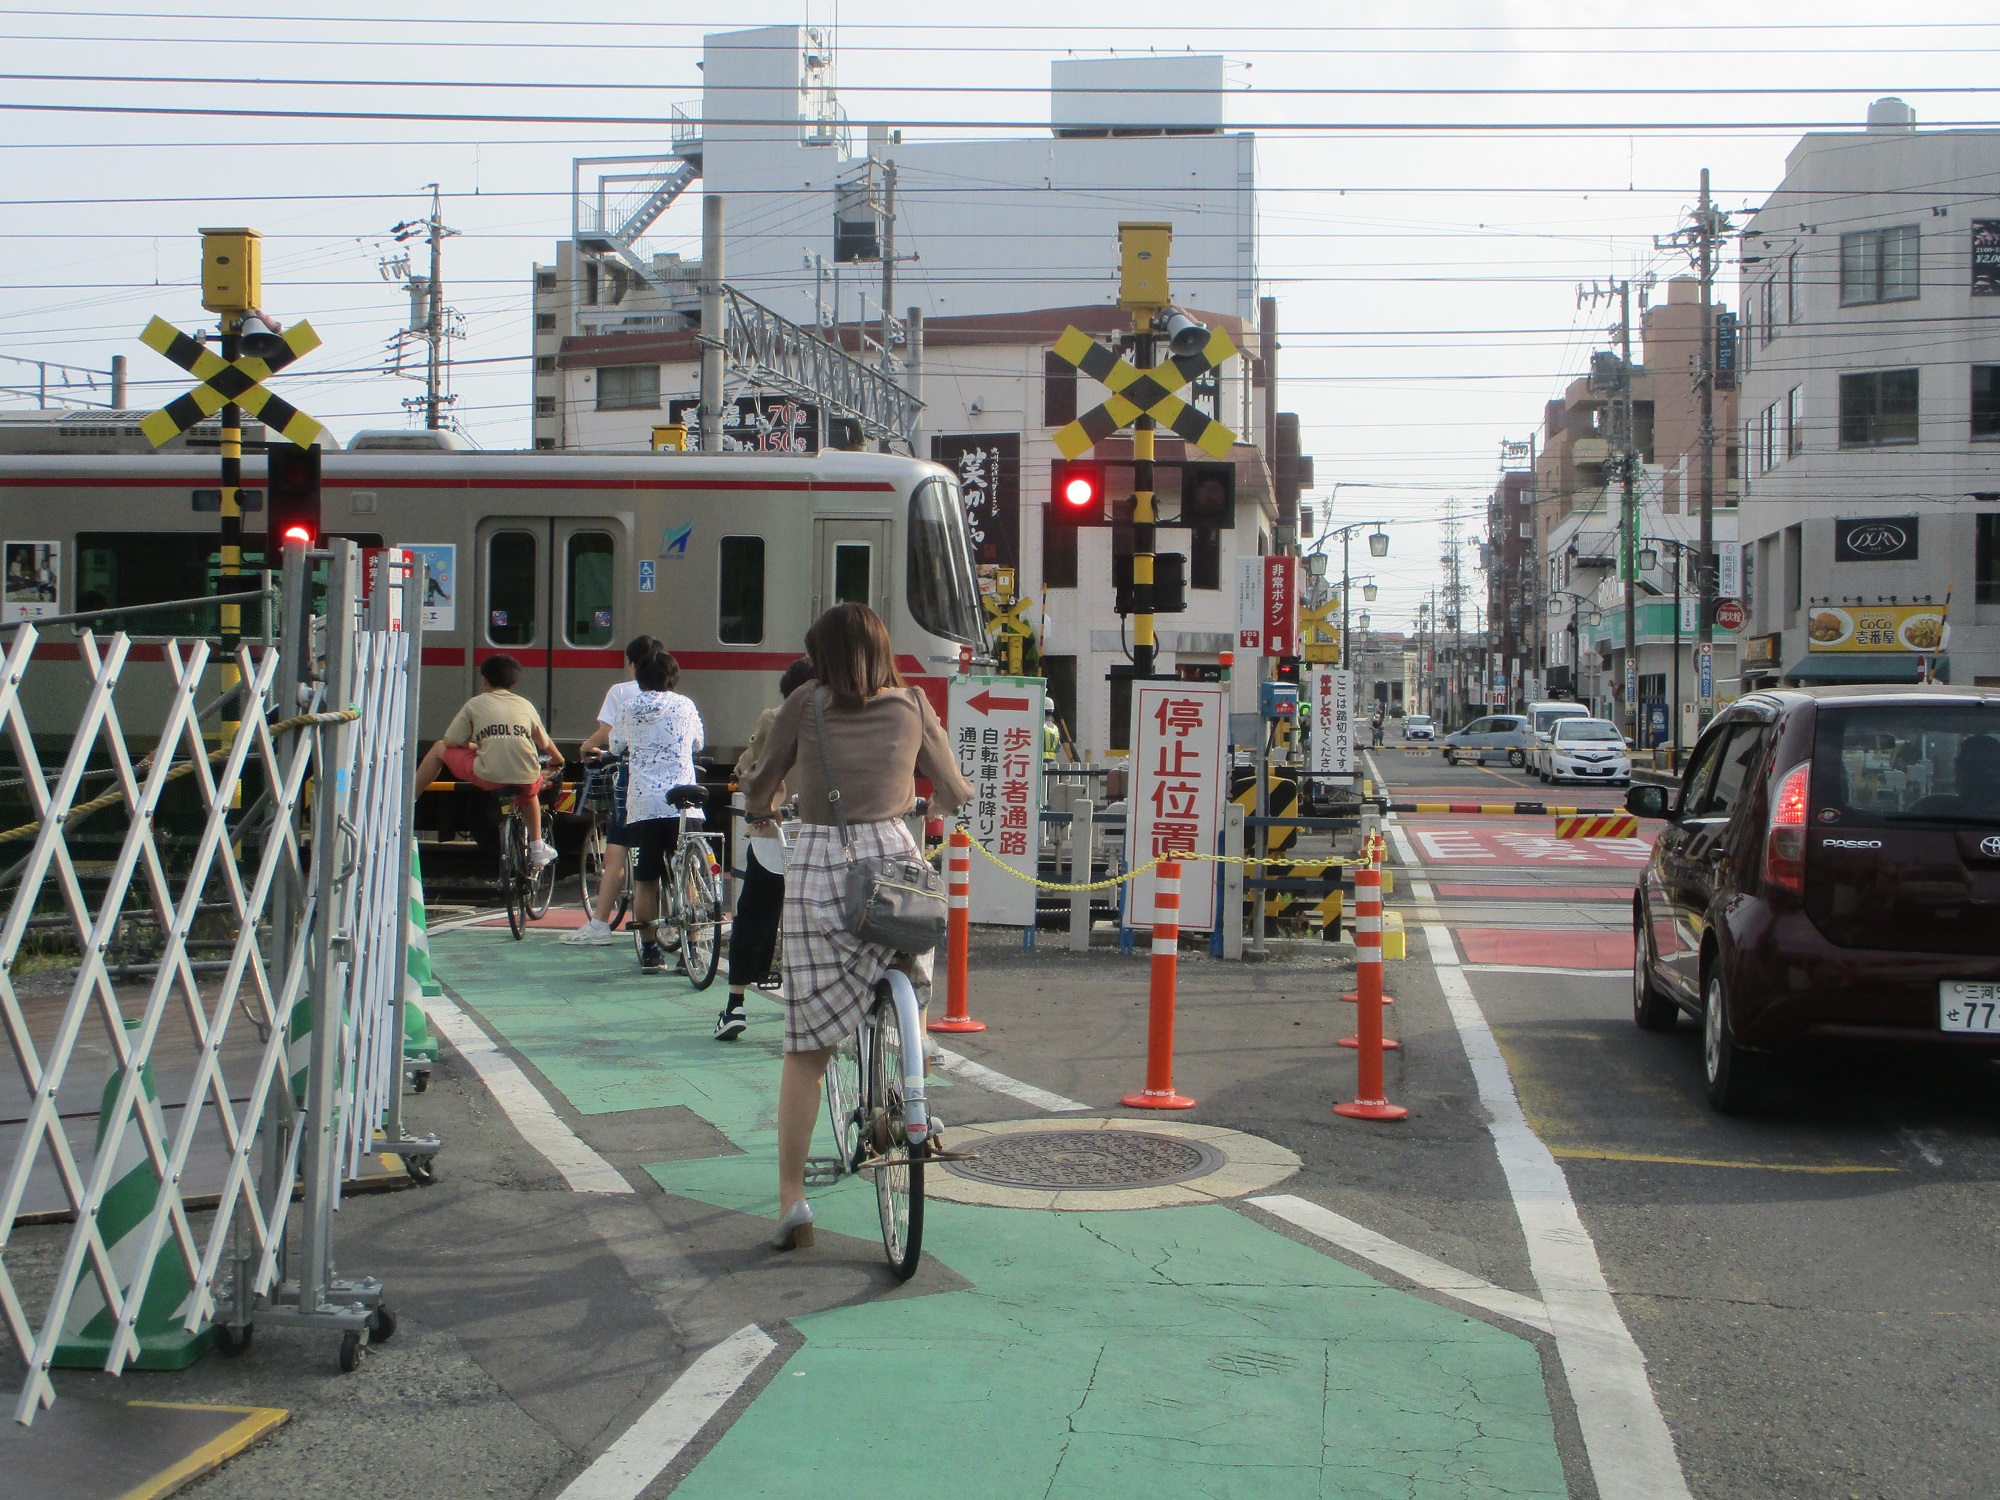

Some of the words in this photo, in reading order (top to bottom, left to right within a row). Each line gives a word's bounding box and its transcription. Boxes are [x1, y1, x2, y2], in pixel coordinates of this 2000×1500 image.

[1719, 348, 1731, 369] Bar
[681, 403, 740, 428] 宴場
[1272, 563, 1285, 626] 非常ボタン
[1719, 611, 1742, 622] 消火栓
[1859, 619, 1892, 629] CoCo
[1855, 630, 1895, 645] 壱番屋
[1336, 675, 1348, 772] ここは踏切内です。
[1150, 697, 1204, 861] 停止位置
[978, 727, 999, 854] 自転車は降りて
[999, 727, 1032, 856] 歩行者通路
[1822, 839, 1882, 849] PASSO
[1966, 985, 1994, 999] 三河
[1946, 1008, 1960, 1022] せ
